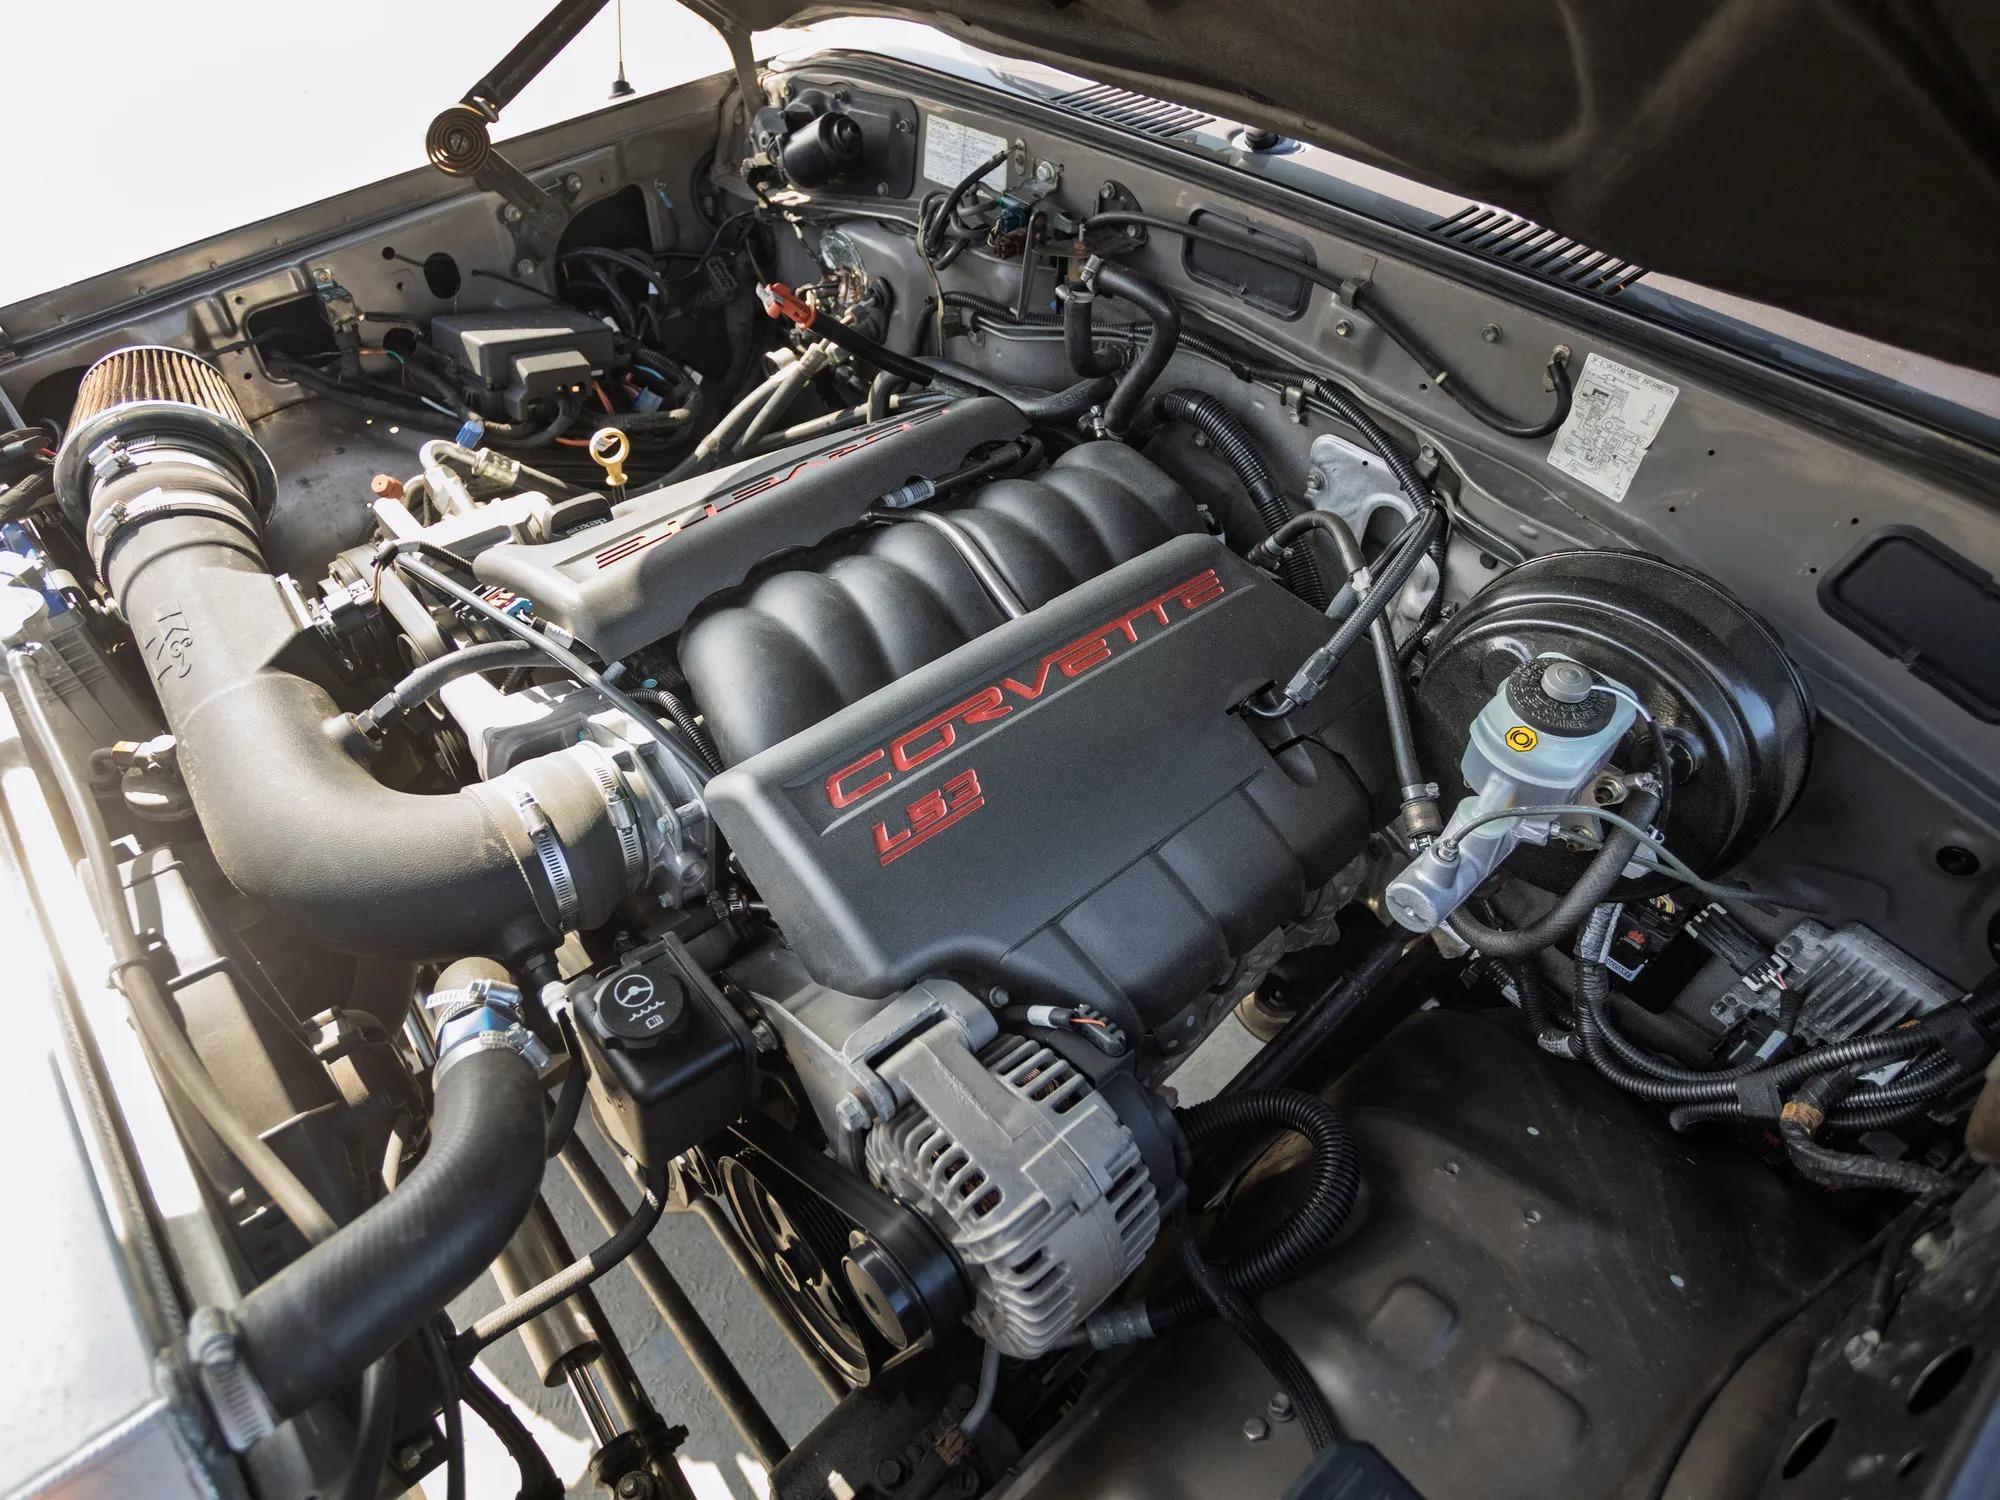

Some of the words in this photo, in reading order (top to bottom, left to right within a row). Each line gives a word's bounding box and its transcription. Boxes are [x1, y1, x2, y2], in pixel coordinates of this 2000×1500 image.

[565, 517, 607, 535] dexos
[825, 568, 1225, 809] CORVETTE
[871, 768, 983, 856] LS3
